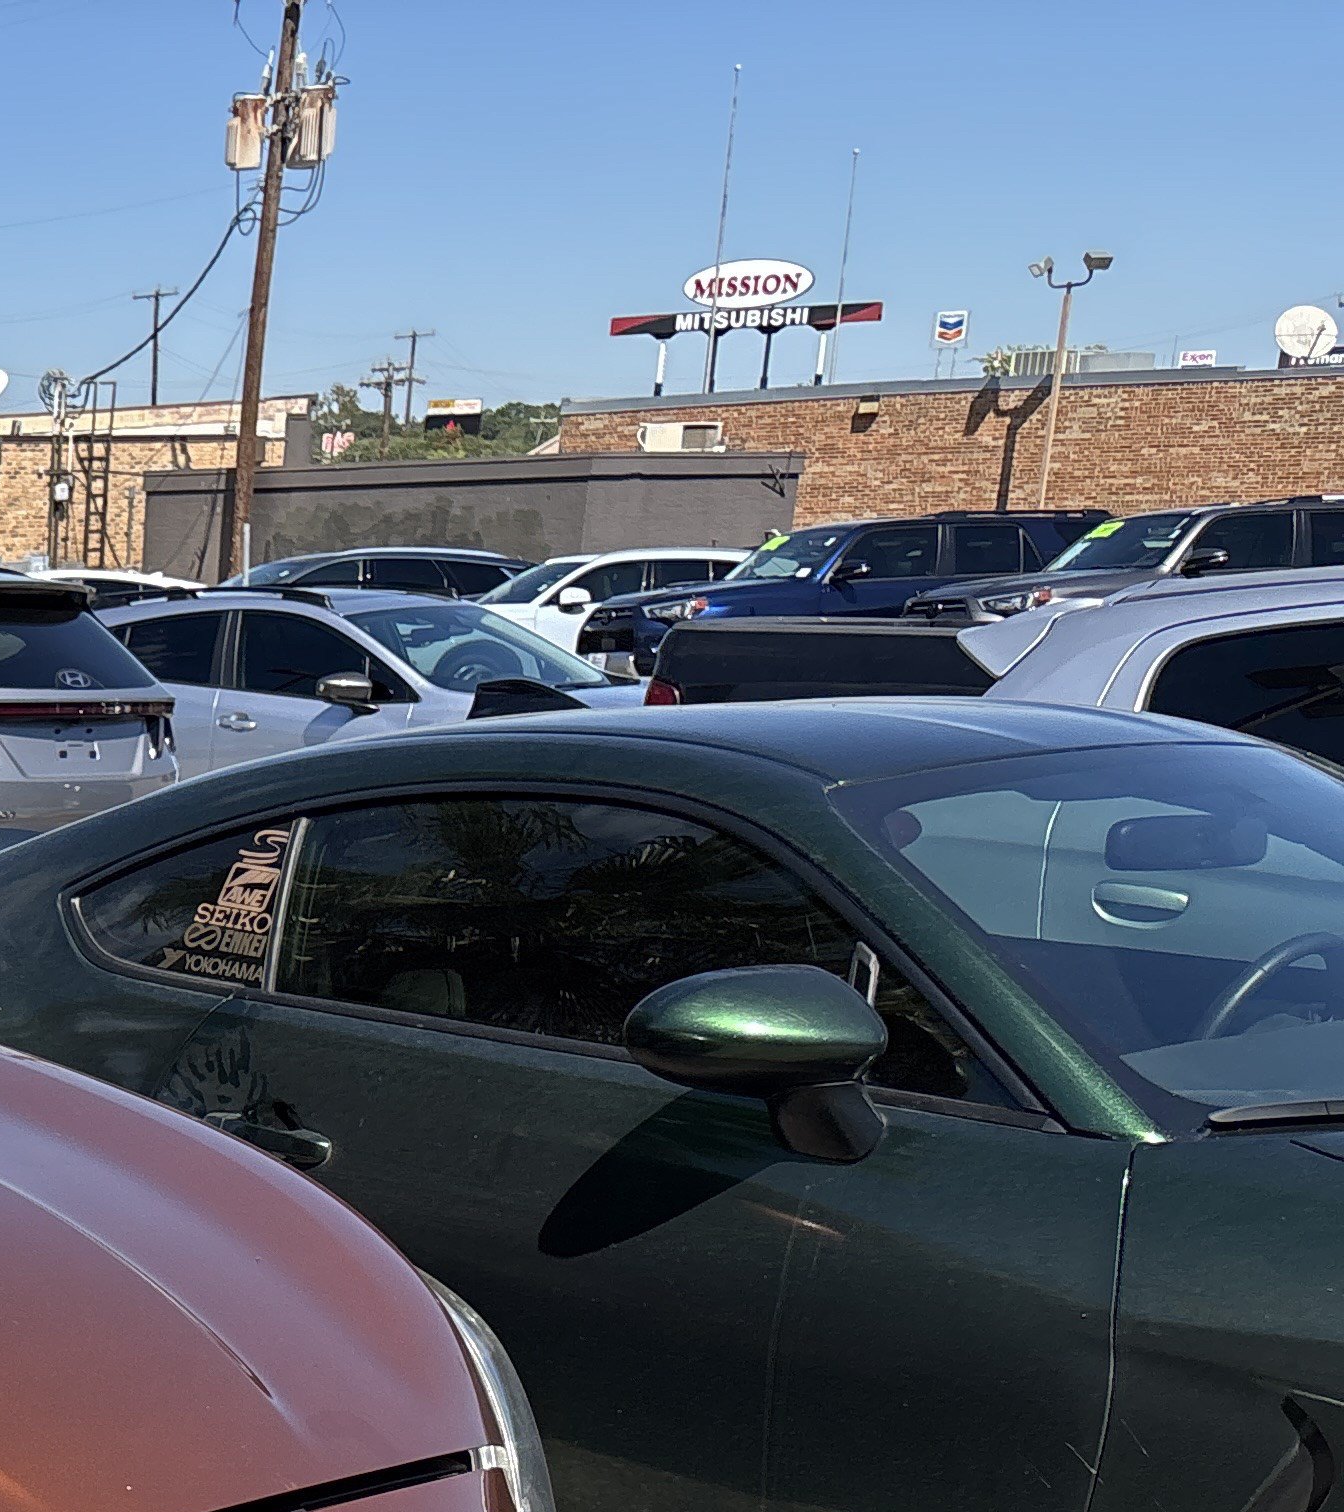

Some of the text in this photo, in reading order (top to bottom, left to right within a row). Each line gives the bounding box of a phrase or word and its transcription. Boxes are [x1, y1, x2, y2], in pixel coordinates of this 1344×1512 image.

[693, 272, 803, 299] MISSION
[675, 307, 810, 331] MITSUBISHI
[1182, 352, 1214, 364] Exxon
[222, 886, 268, 906] AWE
[194, 903, 273, 934] SEIKO
[219, 930, 268, 958] ENKEI
[184, 953, 263, 982] YOKOHAMA
